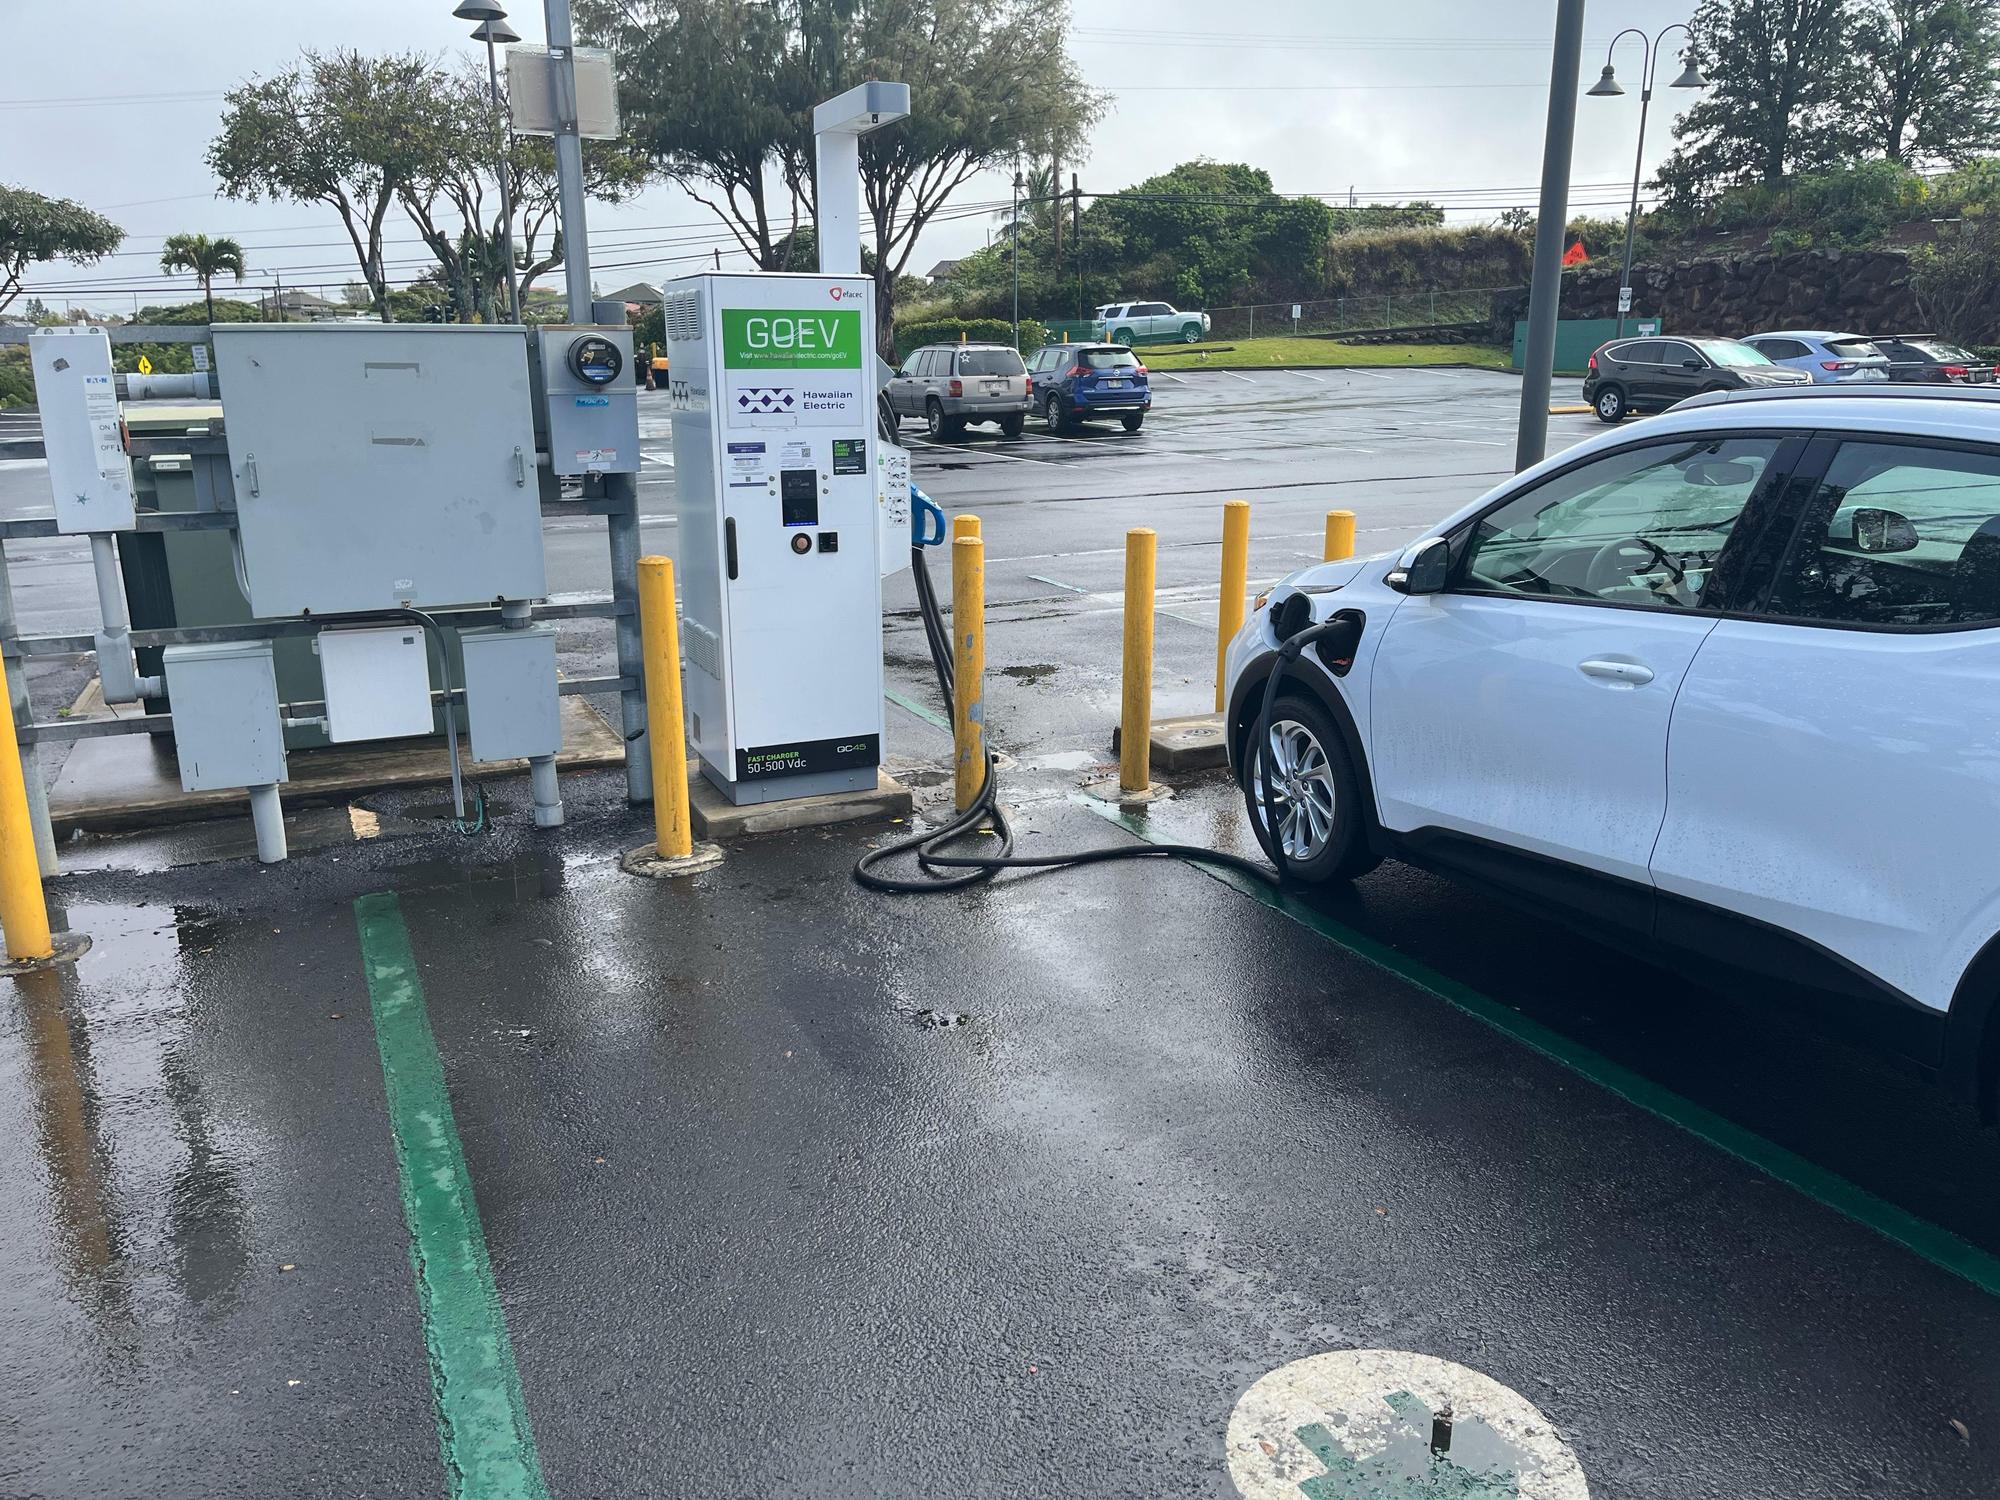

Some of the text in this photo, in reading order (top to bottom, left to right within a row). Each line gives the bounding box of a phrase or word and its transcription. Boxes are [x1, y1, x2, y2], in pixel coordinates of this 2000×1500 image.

[842, 290, 863, 298] efacec
[746, 317, 840, 348] GOEV
[739, 351, 753, 359] Visit
[803, 391, 853, 399] Hawaiian
[803, 401, 846, 410] Electric
[747, 751, 800, 763] FAST CHARGER
[747, 759, 807, 774] 50-500 Vdc
